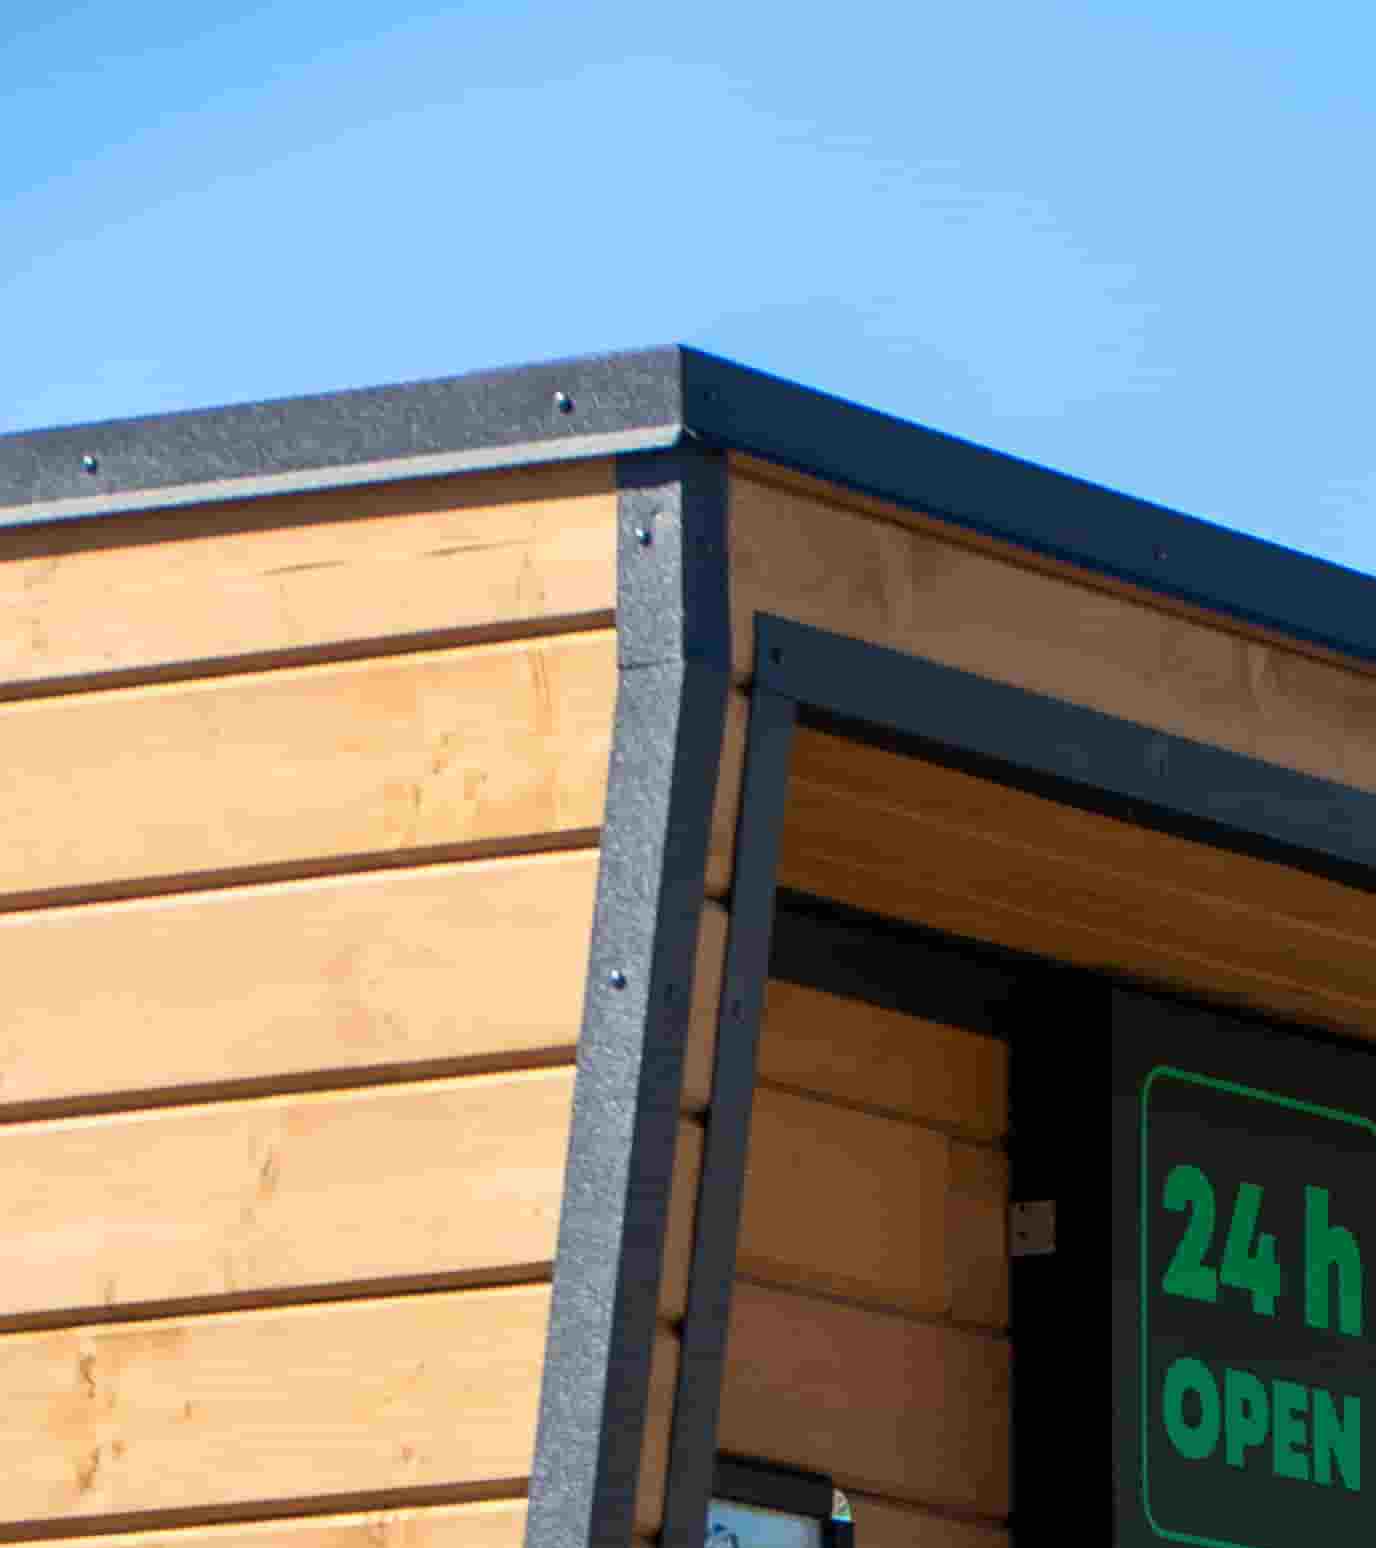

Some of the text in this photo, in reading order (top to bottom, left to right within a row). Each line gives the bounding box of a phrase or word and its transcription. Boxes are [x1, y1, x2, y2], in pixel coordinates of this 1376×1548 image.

[1161, 1164, 1362, 1337] 24 h
[1161, 1357, 1362, 1492] OPEN
